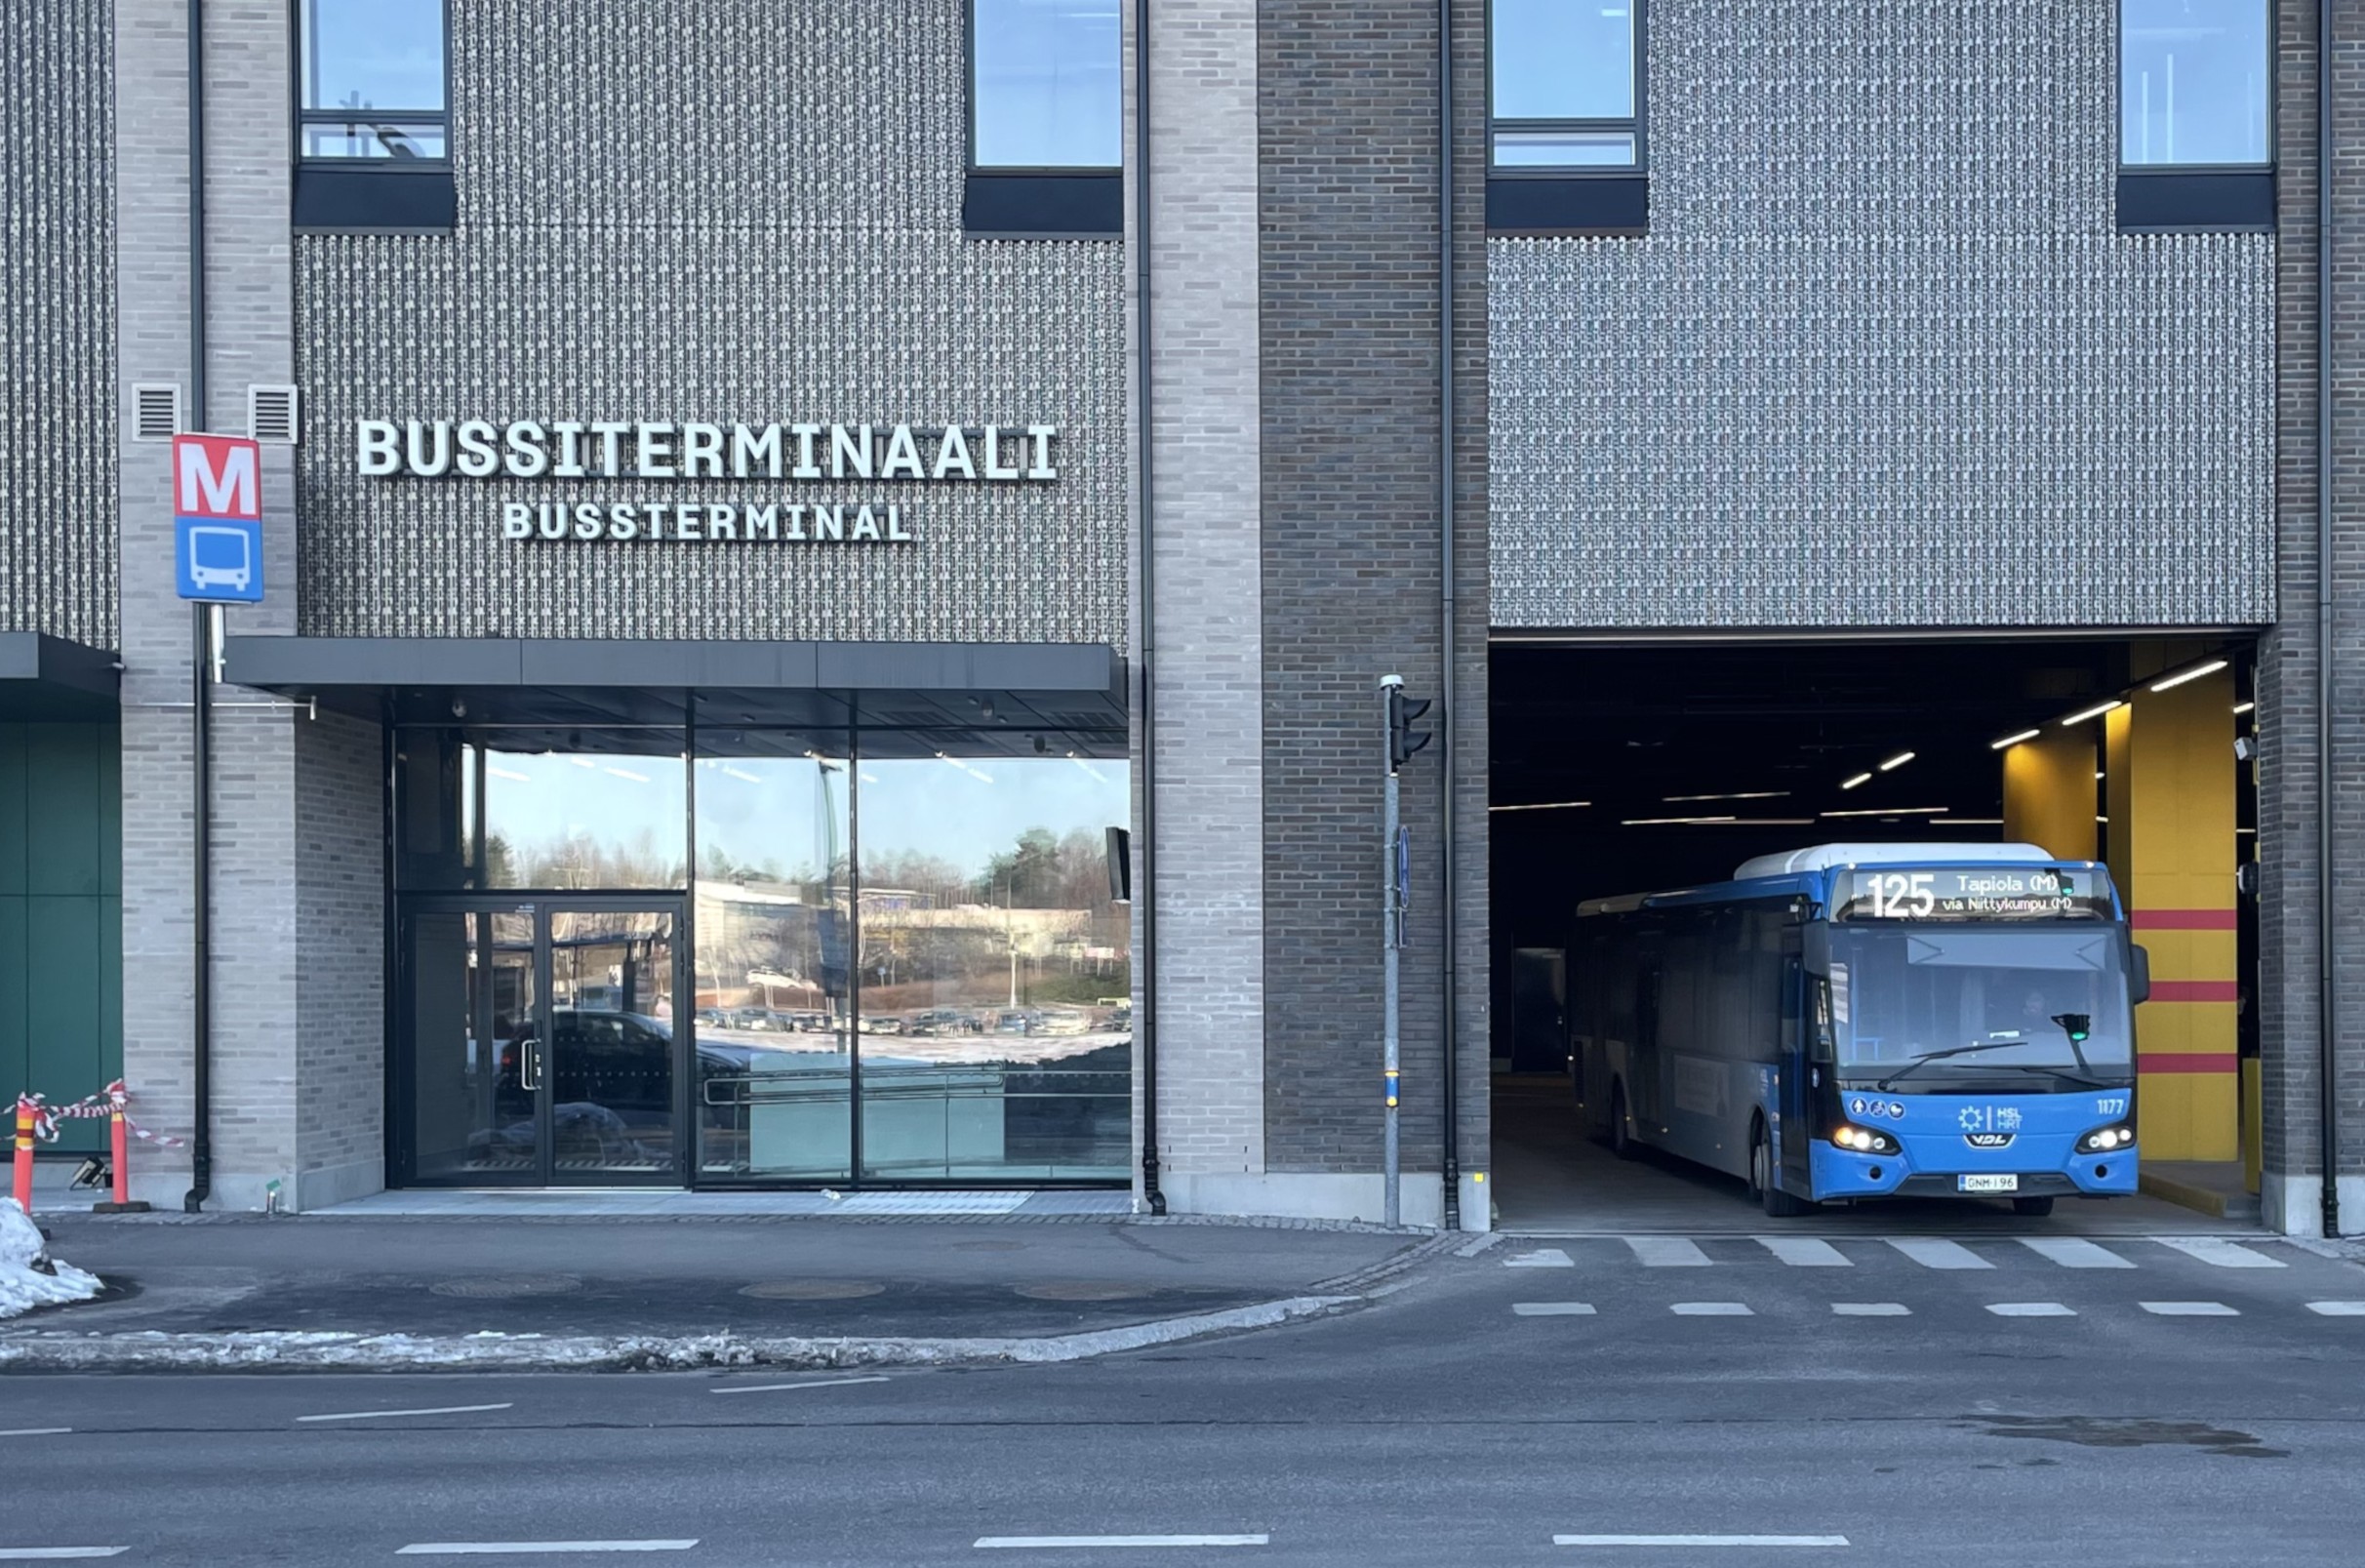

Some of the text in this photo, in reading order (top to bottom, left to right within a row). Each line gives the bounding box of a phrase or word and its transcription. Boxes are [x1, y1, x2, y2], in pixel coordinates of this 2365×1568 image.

[358, 421, 1057, 479] BUSSITERMINAALI
[179, 442, 256, 515] M
[503, 503, 911, 541] BUSSTERMINAL
[1956, 874, 2058, 895] Tapiola (M)
[1867, 874, 1935, 918] 125
[1943, 898, 1964, 910] via
[2051, 897, 2072, 910] (M)
[1997, 1107, 2021, 1118] HSL
[2097, 1099, 2125, 1114] 1177
[1971, 1134, 2007, 1145] VDL
